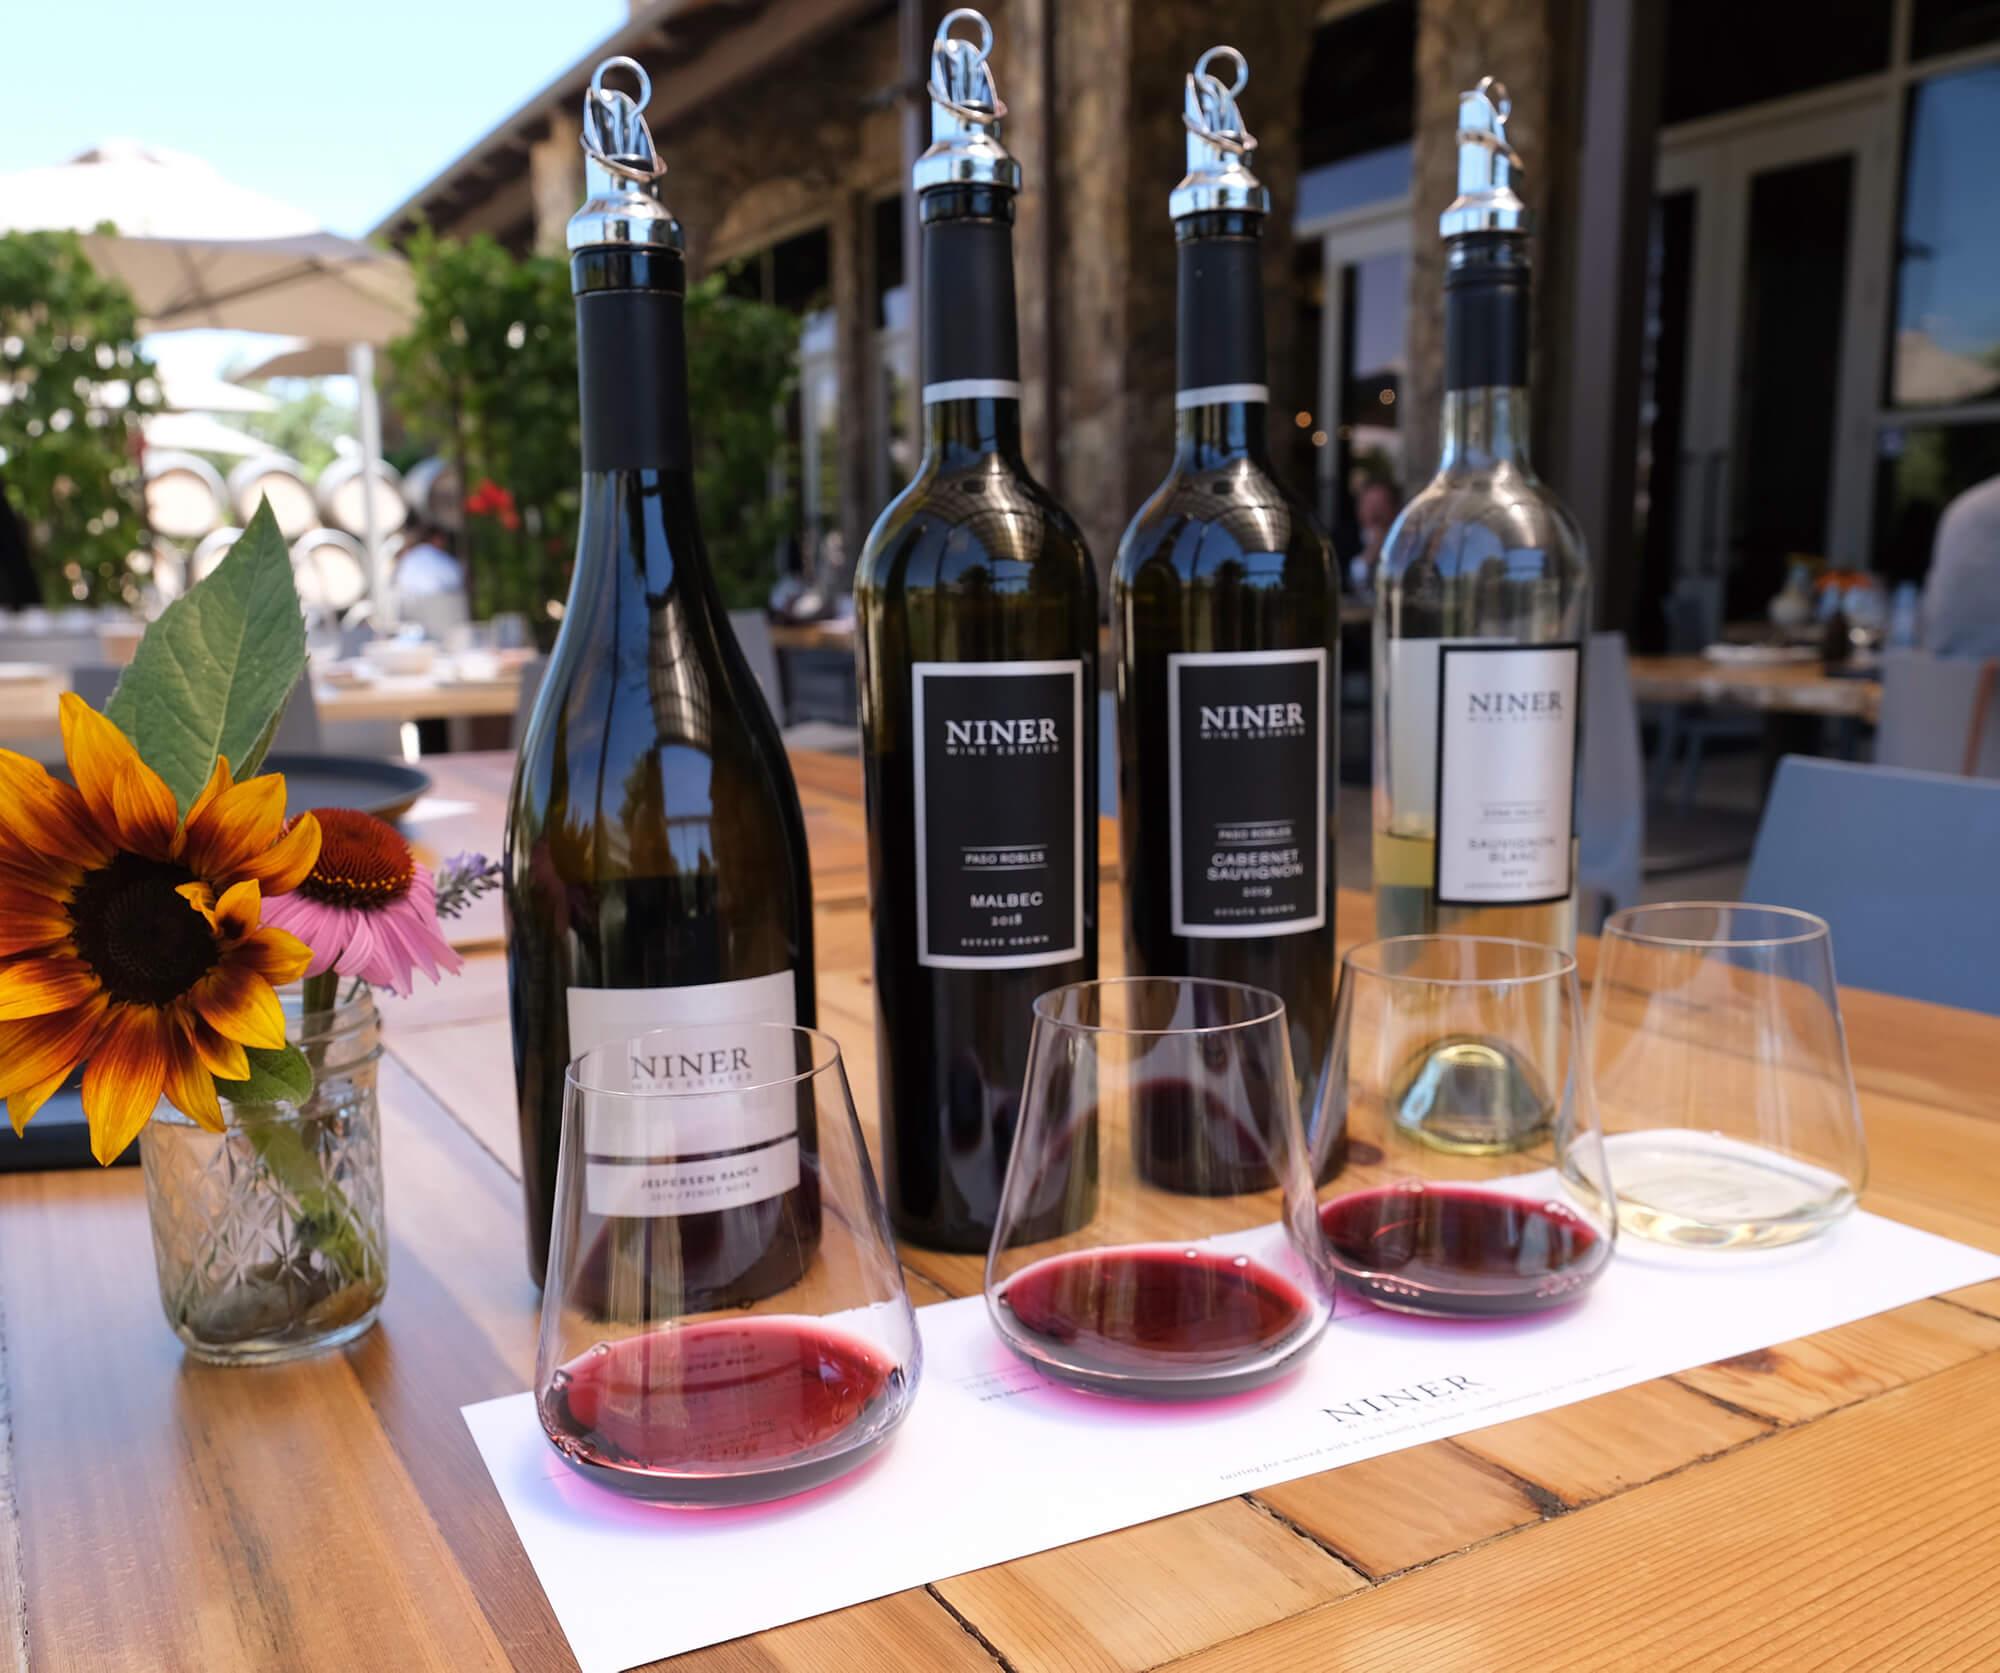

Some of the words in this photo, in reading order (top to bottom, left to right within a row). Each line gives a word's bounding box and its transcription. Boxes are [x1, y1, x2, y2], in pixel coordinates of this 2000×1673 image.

[1469, 691, 1562, 713] NINER
[1200, 702, 1305, 730] NINER
[945, 718, 1059, 745] NINER
[946, 745, 986, 755] WINE
[996, 744, 1058, 755] ESTATES
[1218, 829, 1249, 840] PASO
[1250, 826, 1292, 839] ROBLES
[965, 853, 998, 864] PASO
[999, 851, 1044, 864] ROBLES
[1211, 849, 1299, 867] CABERNET
[1207, 863, 1303, 881] SAUVIGNON
[970, 891, 1043, 908] MALBEC
[991, 913, 1022, 926] 2018
[961, 938, 1004, 946] ESTATE
[1009, 935, 1049, 945] GROWN
[630, 1046, 751, 1079] NINER
[641, 1175, 715, 1188] JESPERSEN
[721, 1166, 759, 1180] RANCH
[1321, 1375, 1486, 1423] NINER
